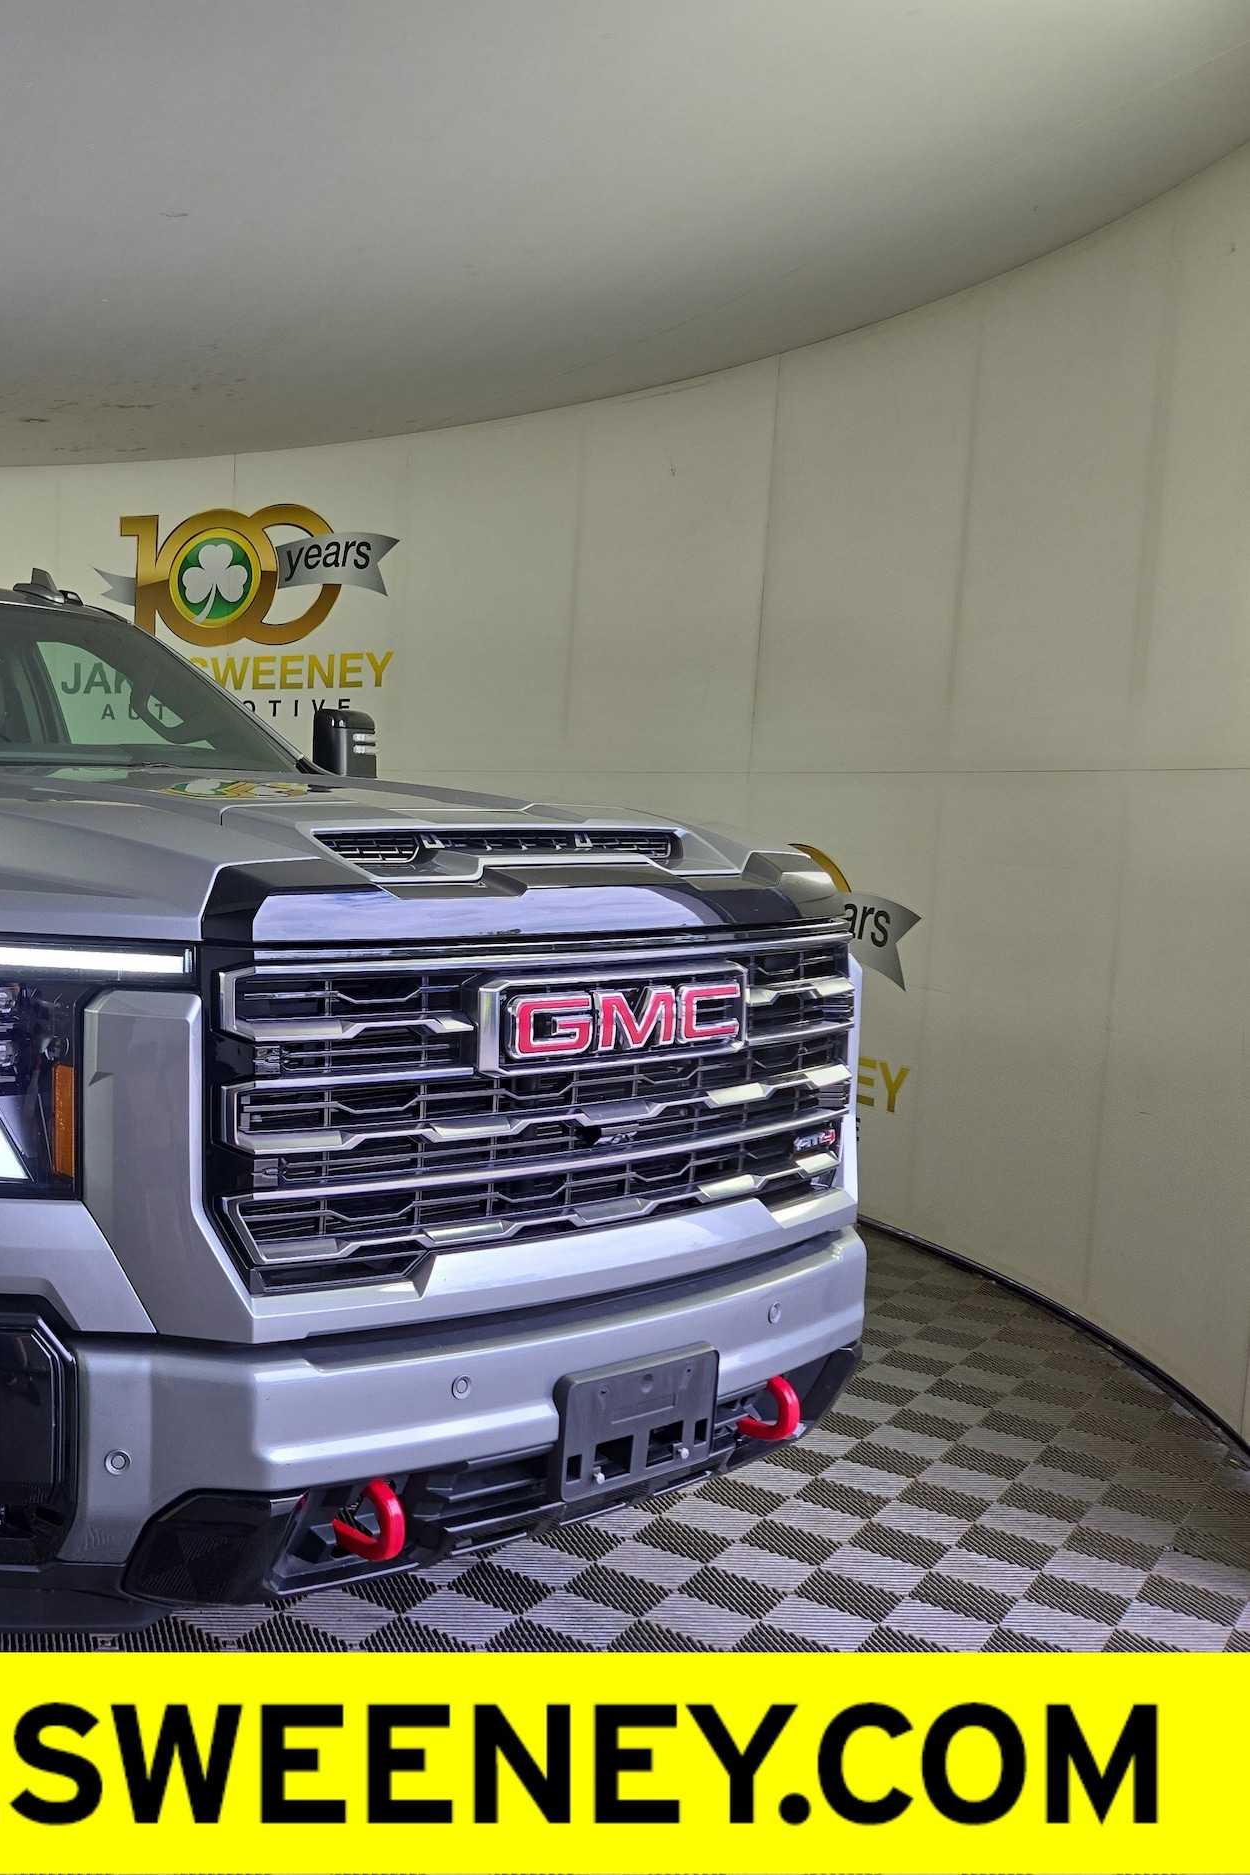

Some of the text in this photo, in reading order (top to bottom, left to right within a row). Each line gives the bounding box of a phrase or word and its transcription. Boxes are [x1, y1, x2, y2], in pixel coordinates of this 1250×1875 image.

[284, 539, 372, 581] years
[844, 903, 891, 948] ars
[507, 982, 741, 1060] GMC
[793, 1129, 837, 1152] AT4
